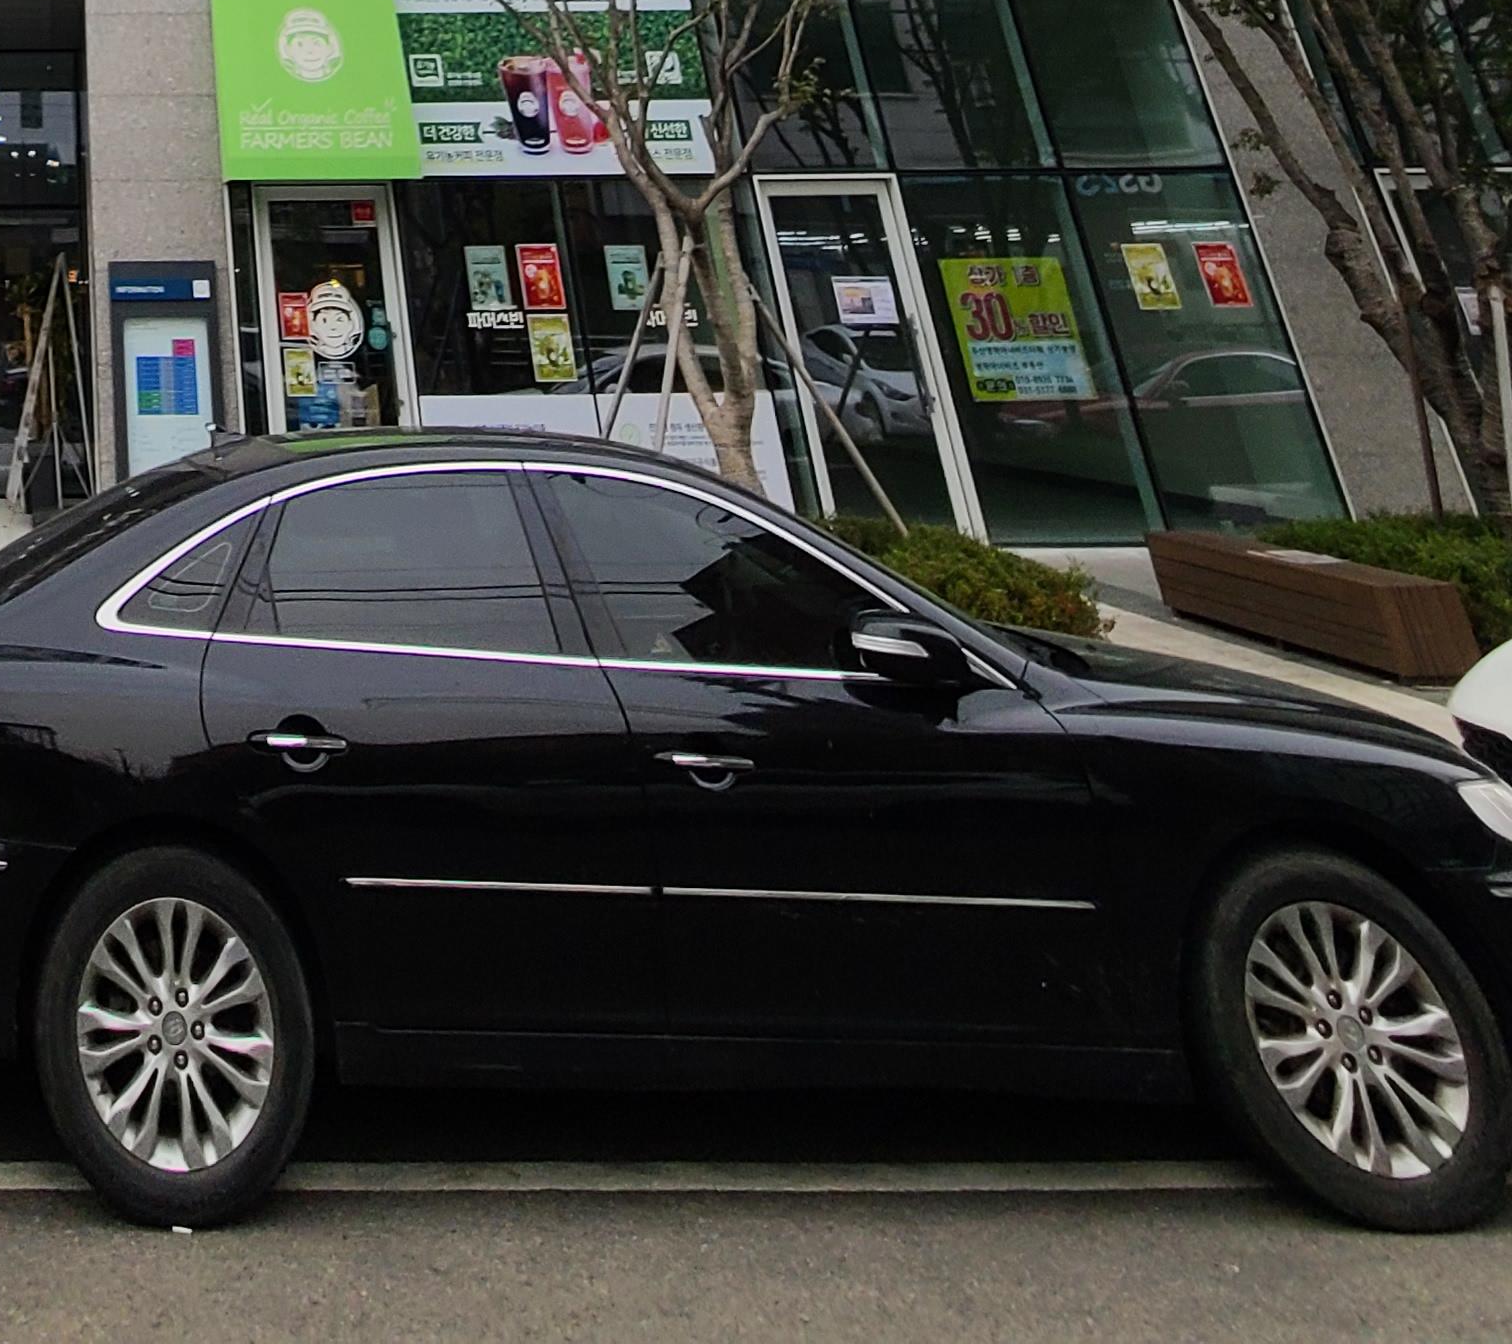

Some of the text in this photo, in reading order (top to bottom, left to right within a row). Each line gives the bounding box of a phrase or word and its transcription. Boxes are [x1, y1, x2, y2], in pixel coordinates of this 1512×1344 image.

[423, 124, 475, 141] 더 건강한
[651, 123, 688, 139] 신선한
[240, 130, 392, 150] FARMERS BEAN
